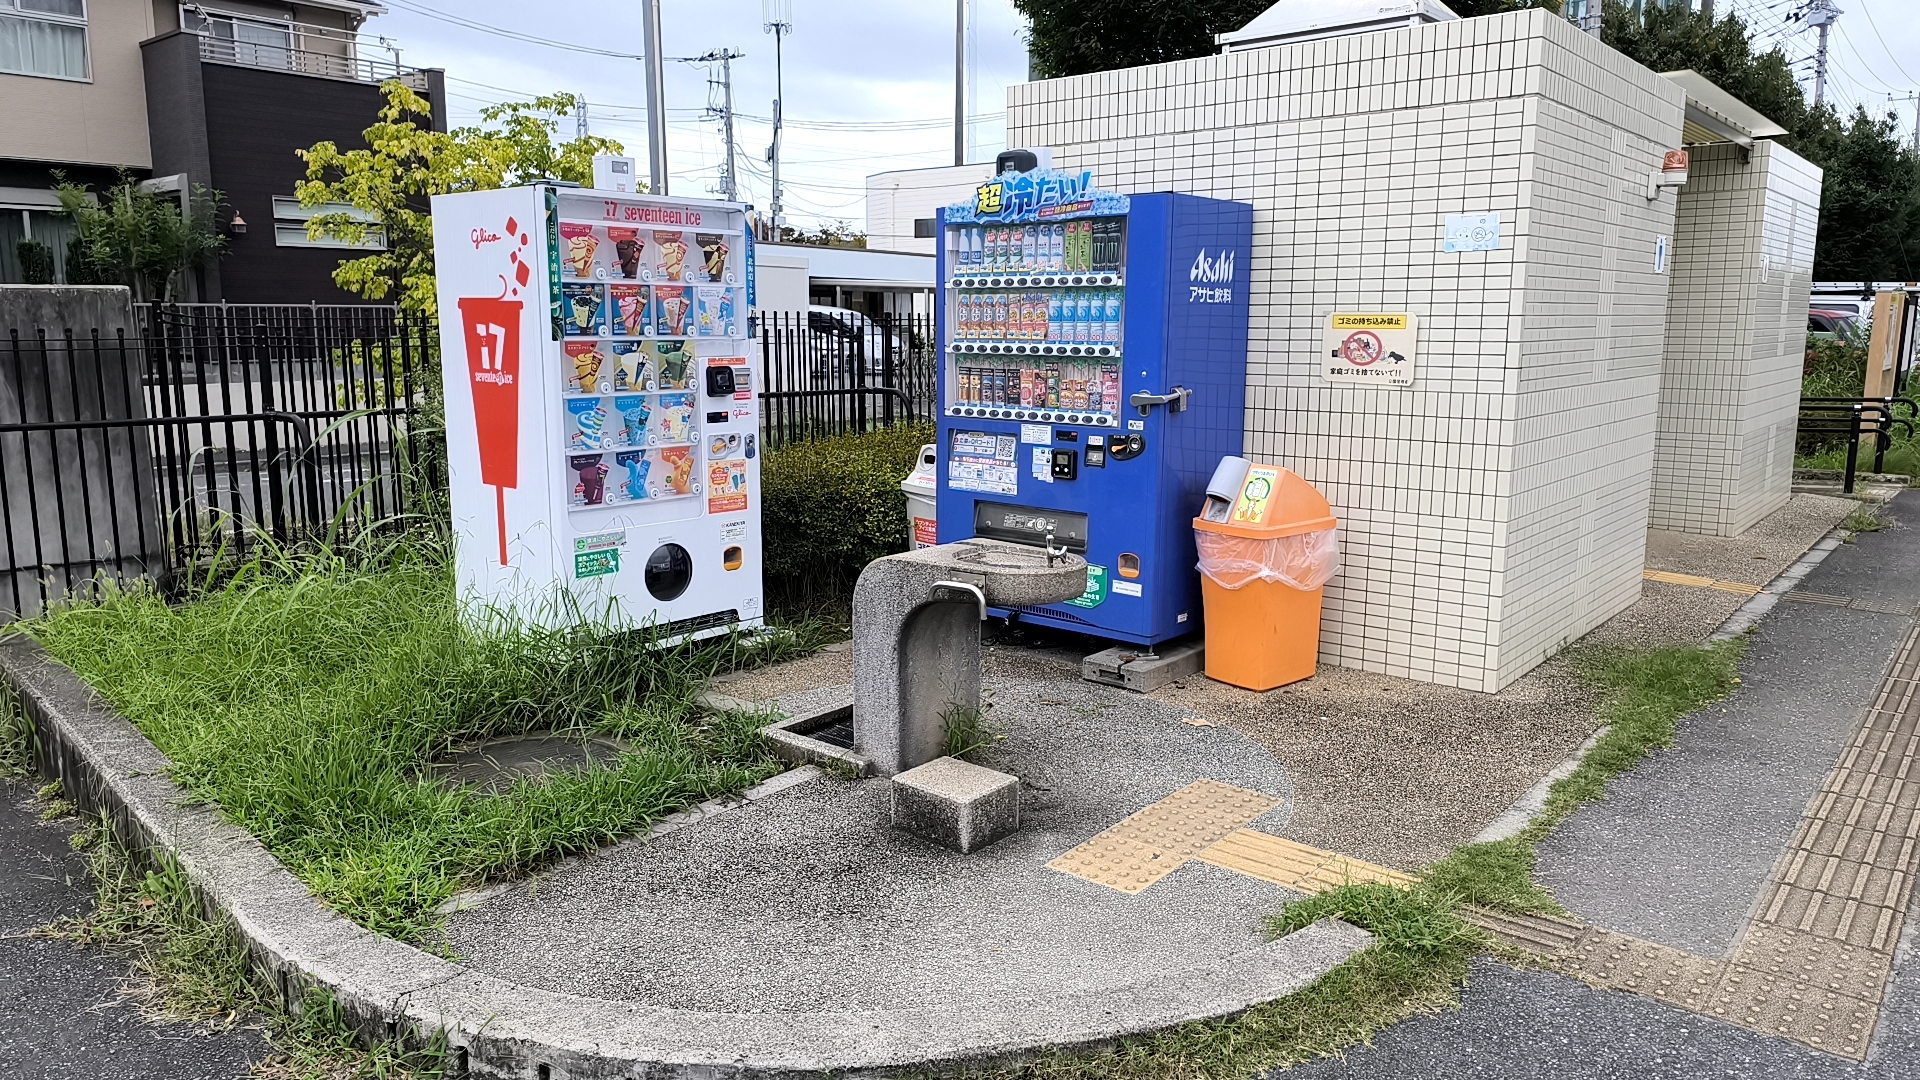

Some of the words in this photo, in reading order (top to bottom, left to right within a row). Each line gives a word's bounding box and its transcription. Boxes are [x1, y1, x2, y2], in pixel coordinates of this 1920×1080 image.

[625, 206, 683, 225] seventeen
[685, 208, 701, 226] ice
[471, 228, 501, 250] Glico
[1190, 247, 1235, 284] Asahi
[1189, 286, 1232, 304] アサヒ飲料
[1338, 317, 1402, 326] ゴミの持ち込み禁止
[1330, 367, 1402, 378] 家庭ゴミを捨てないで!!
[733, 409, 752, 419] Glico
